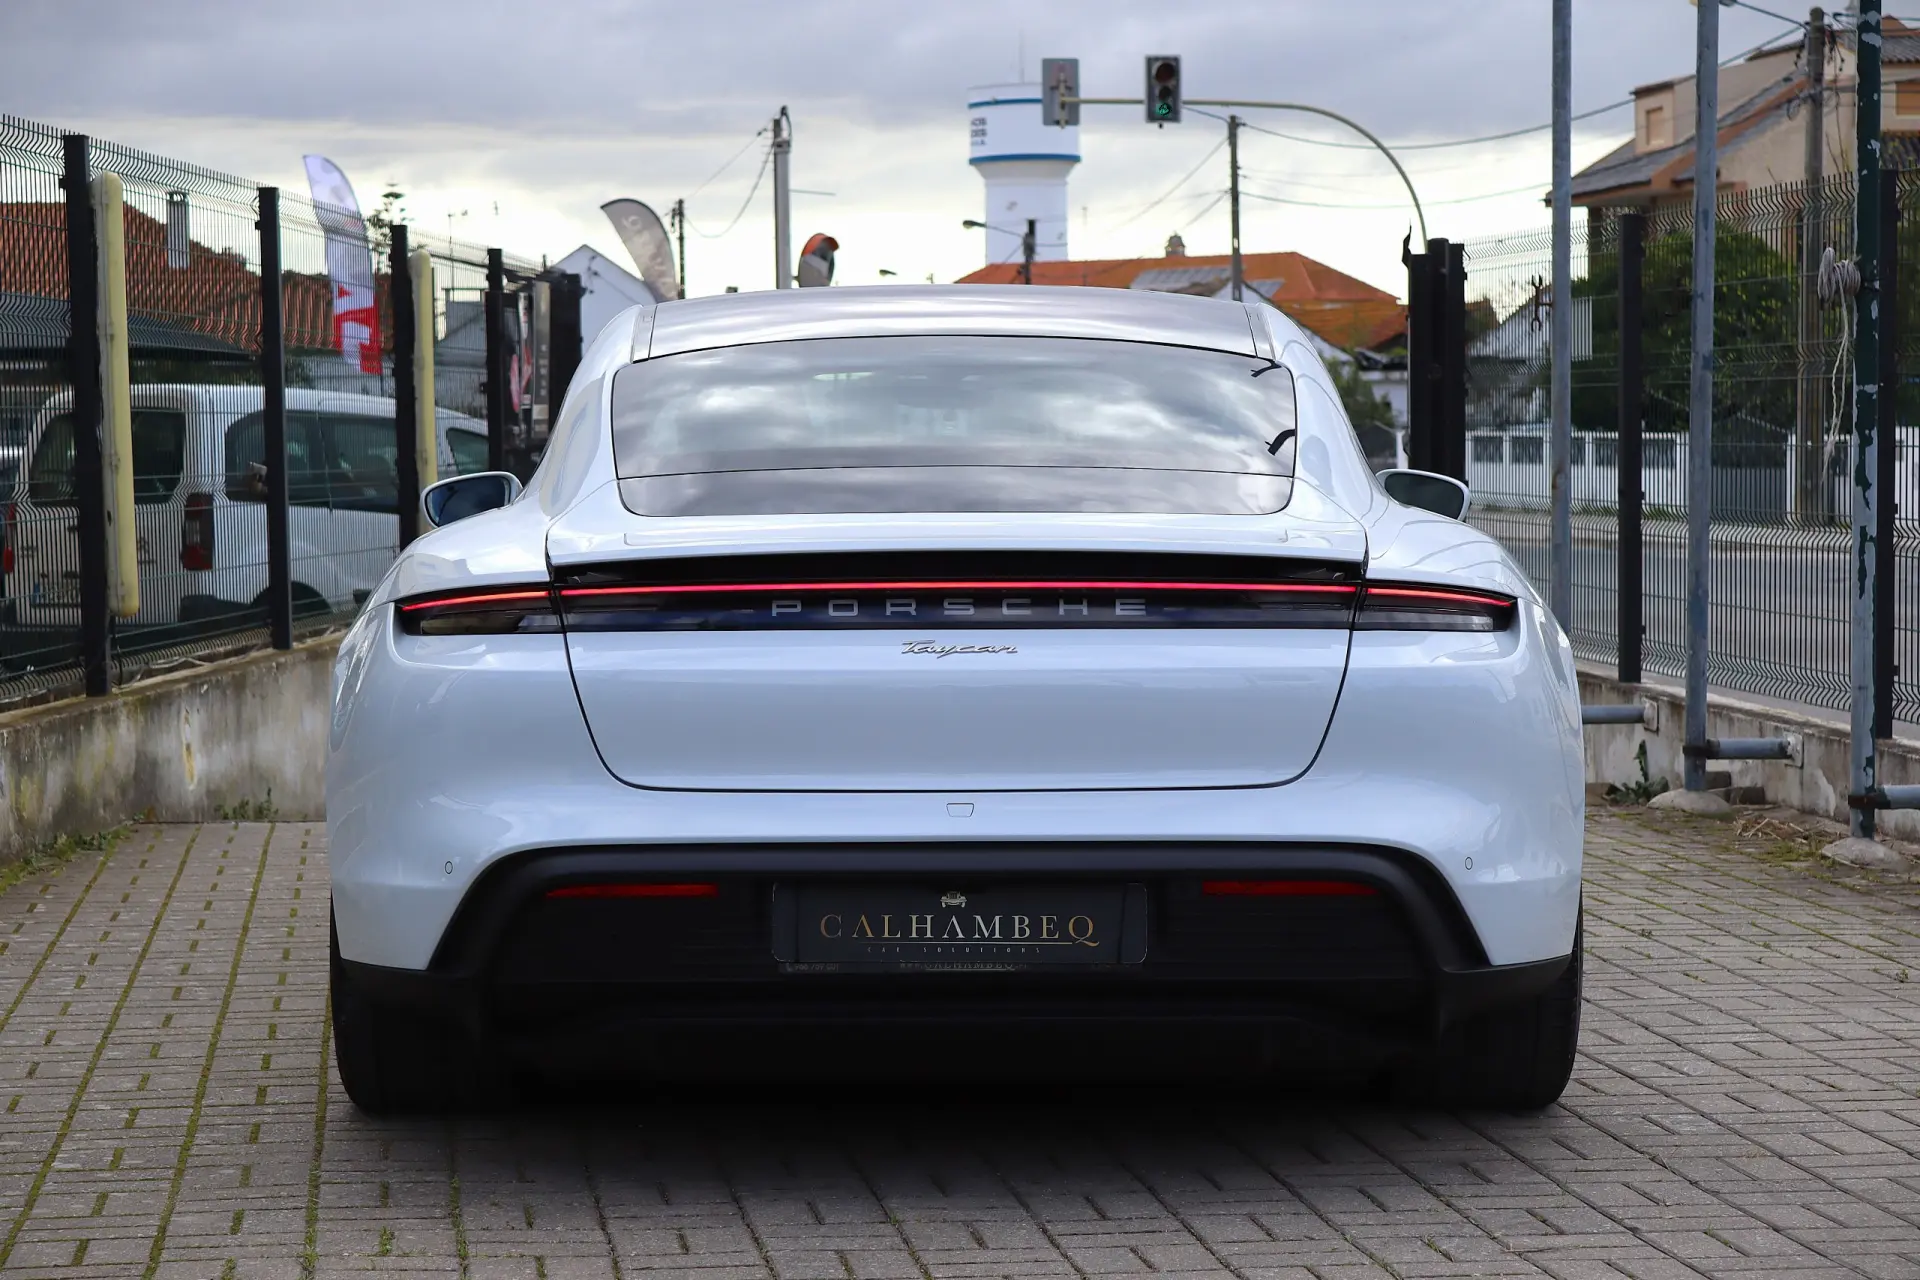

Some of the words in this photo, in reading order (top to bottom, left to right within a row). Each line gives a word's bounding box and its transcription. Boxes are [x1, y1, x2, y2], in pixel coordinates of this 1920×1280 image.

[771, 598, 1147, 616] PORSCHE
[901, 639, 1018, 659] Taycan
[819, 914, 1100, 947] CALHAMBEQ
[923, 946, 1040, 954] SOLUTIONS
